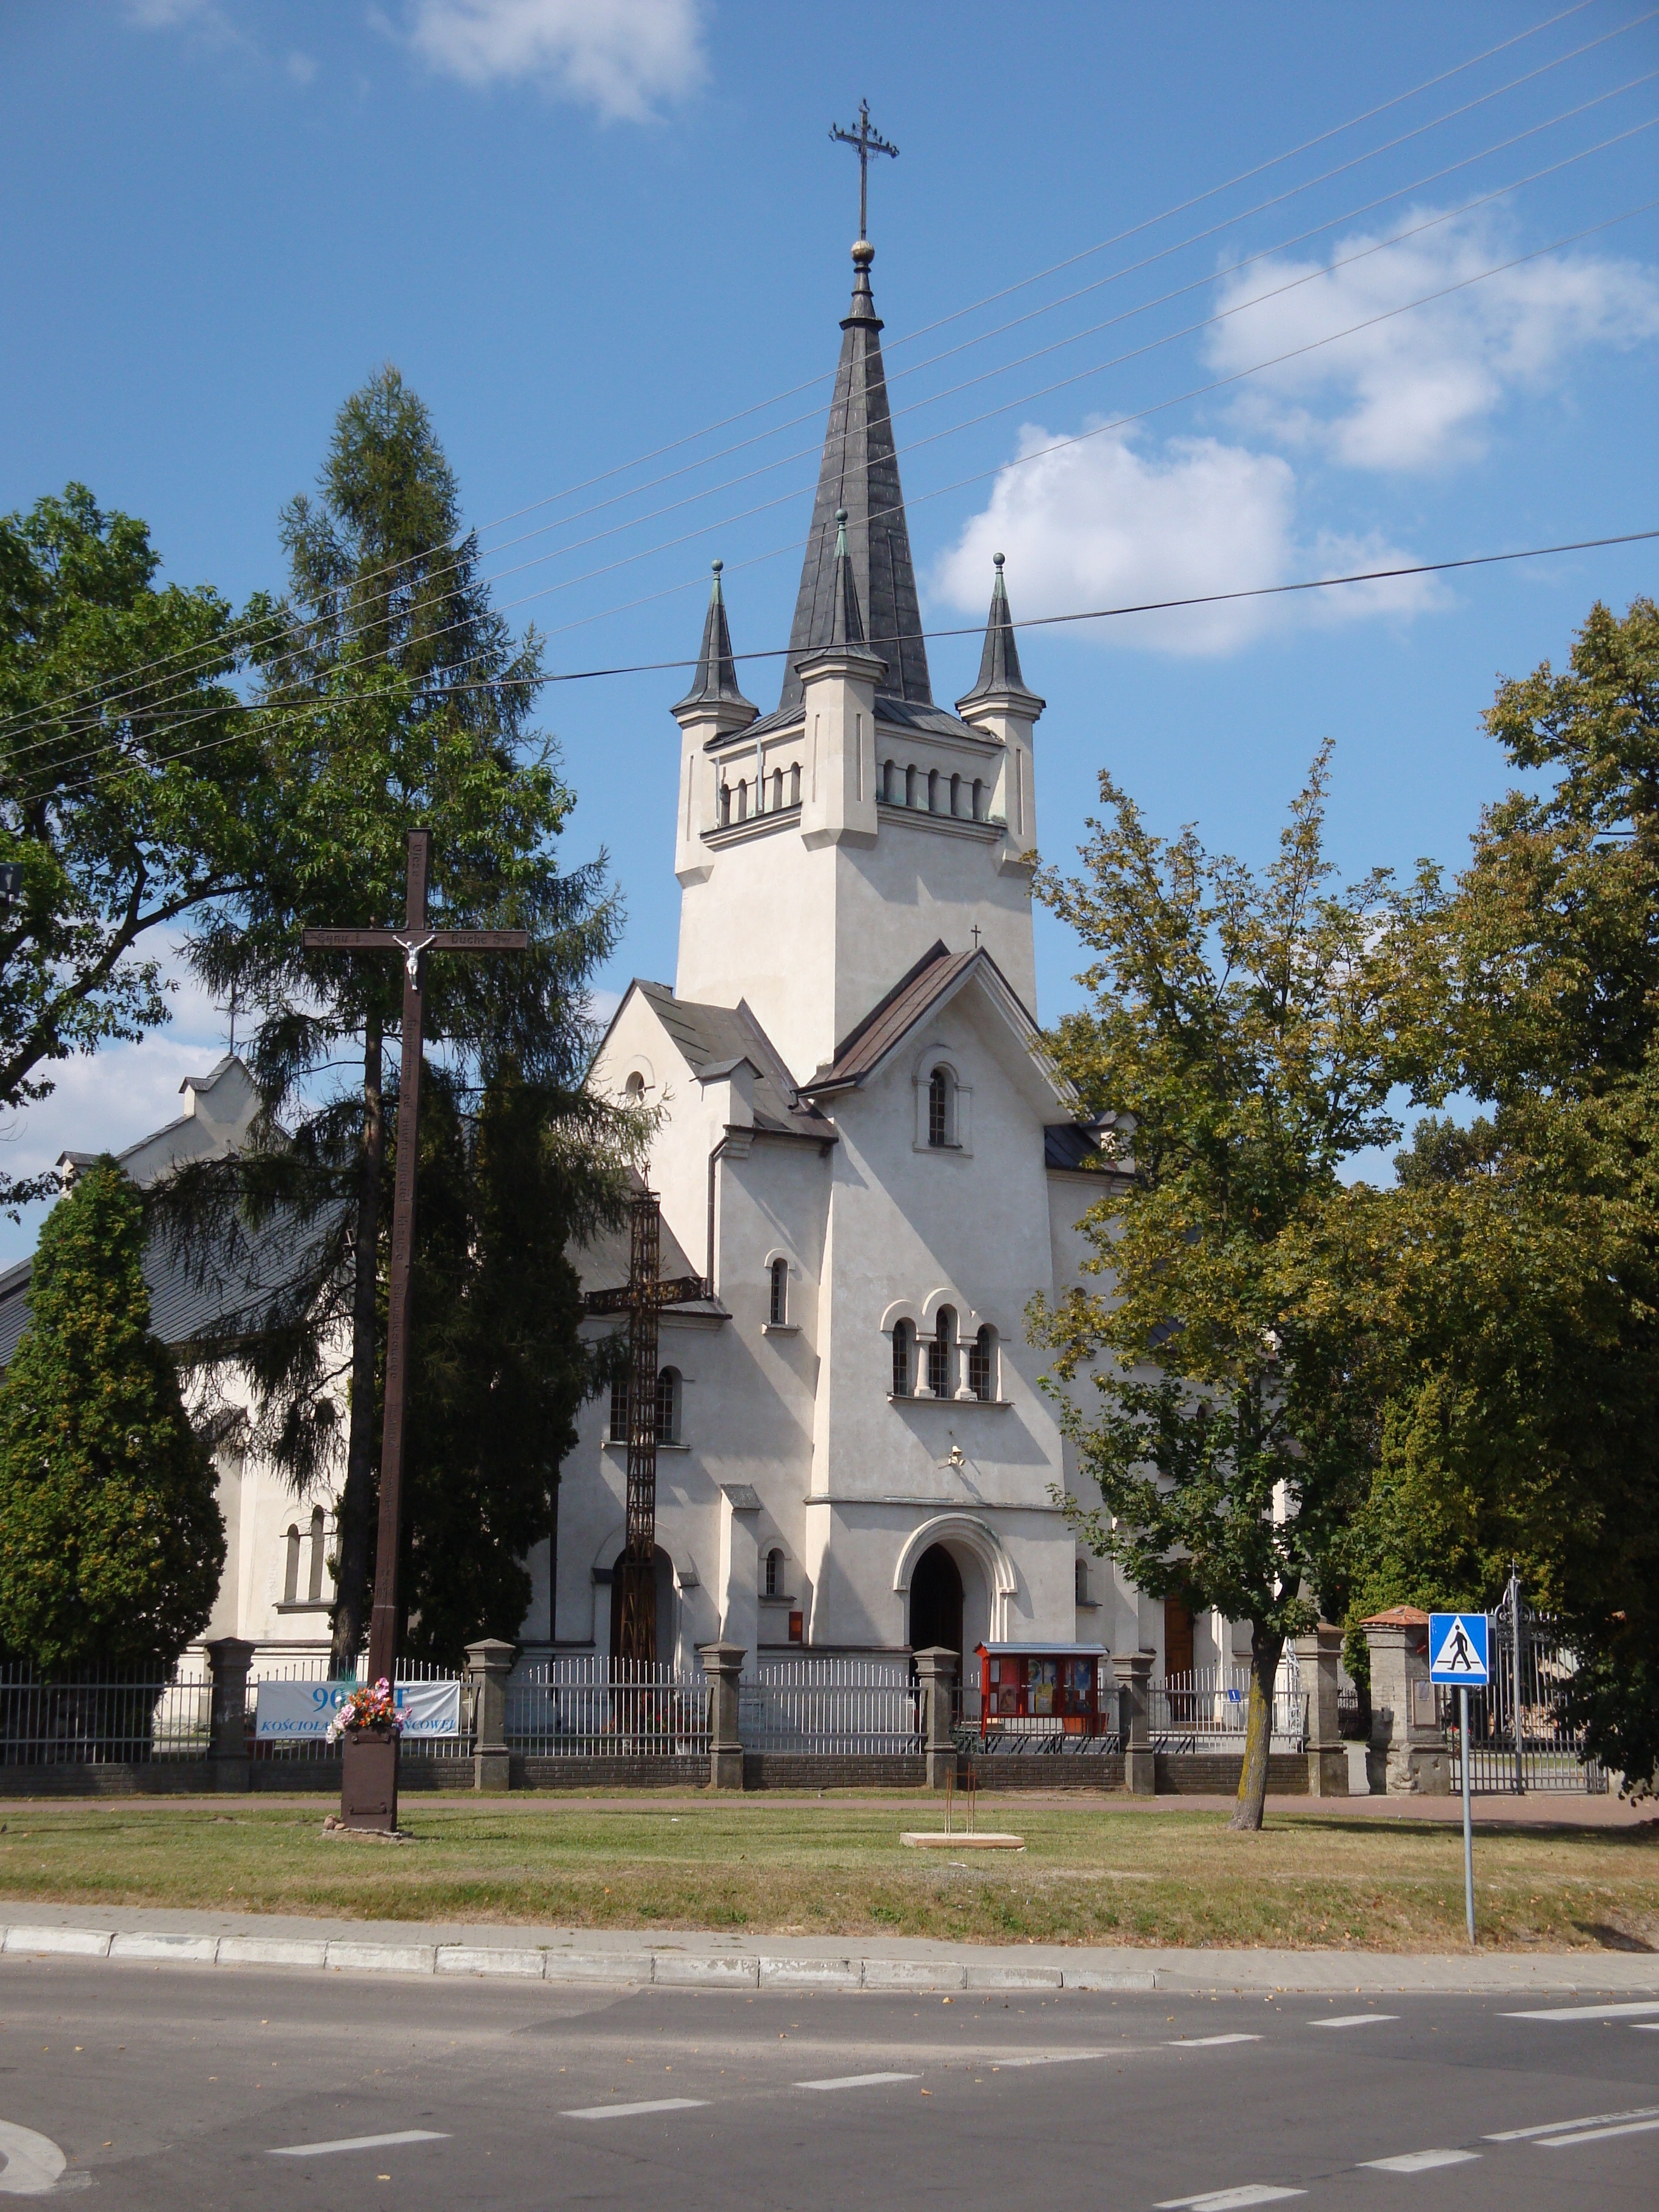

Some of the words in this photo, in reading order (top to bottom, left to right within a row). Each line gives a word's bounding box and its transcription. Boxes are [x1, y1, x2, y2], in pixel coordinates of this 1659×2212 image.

[313, 1687, 346, 1712] 90
[1232, 1691, 1236, 1699] 1
[403, 1718, 455, 1731] ŃCOWEJ
